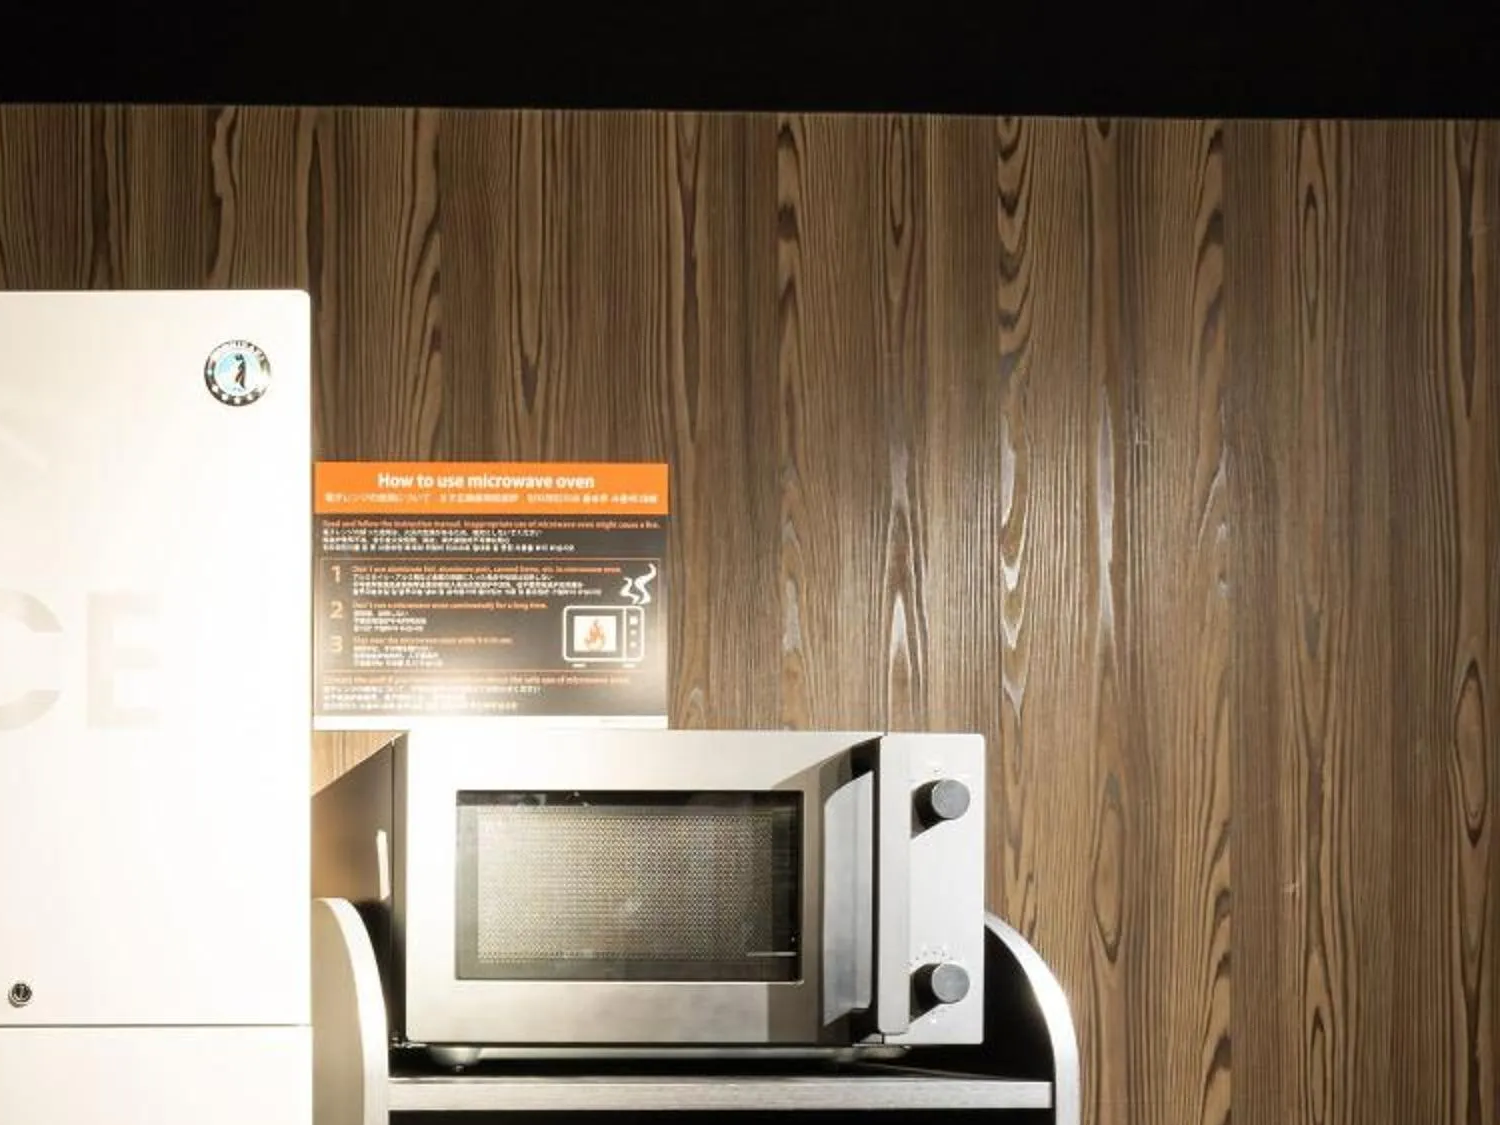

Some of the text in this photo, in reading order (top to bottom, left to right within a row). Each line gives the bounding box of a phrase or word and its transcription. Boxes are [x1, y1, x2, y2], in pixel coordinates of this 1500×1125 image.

[377, 473, 596, 489] How to use microwave oven
[332, 566, 341, 583] 1
[330, 602, 343, 619] 2
[330, 636, 343, 653] 3
